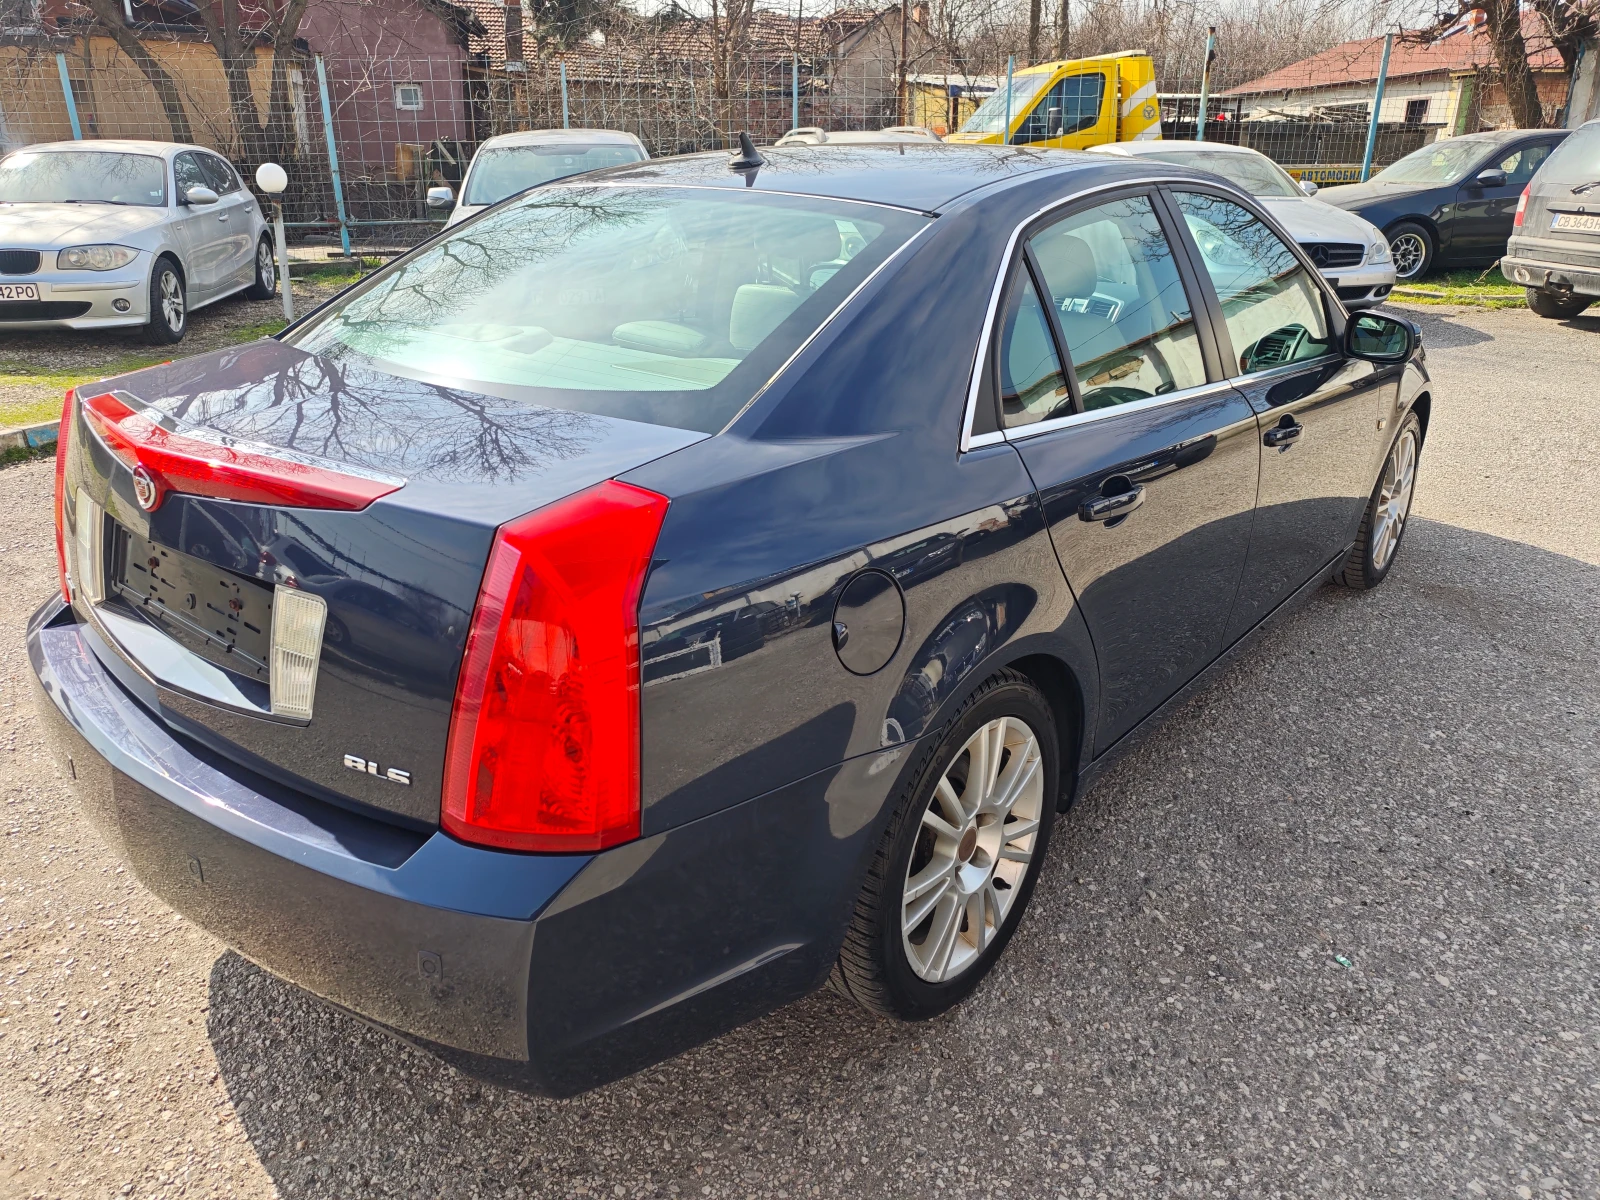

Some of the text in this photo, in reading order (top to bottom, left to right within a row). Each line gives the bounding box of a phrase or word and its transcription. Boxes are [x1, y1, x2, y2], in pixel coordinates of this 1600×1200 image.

[1558, 216, 1571, 227] CB
[1570, 217, 1595, 229] 3643
[344, 754, 411, 785] BLS
